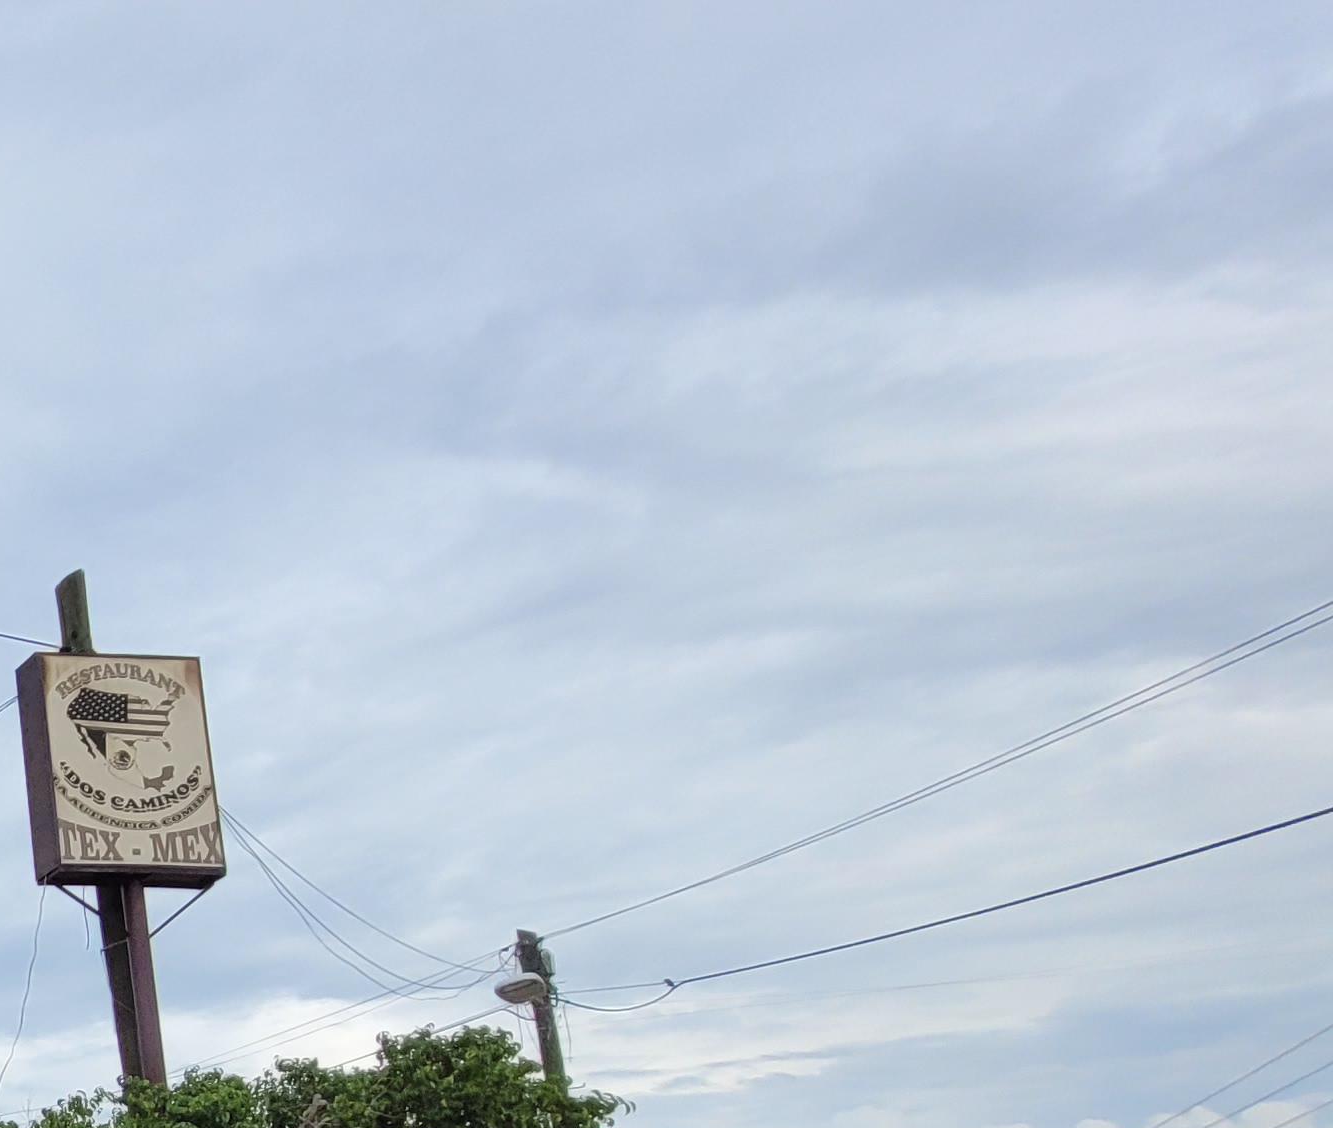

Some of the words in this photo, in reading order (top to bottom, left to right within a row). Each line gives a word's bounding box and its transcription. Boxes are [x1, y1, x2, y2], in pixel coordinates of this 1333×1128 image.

[55, 662, 185, 700] RESTAURANT
[52, 773, 68, 799] LA
[66, 796, 161, 830] AUTENTICA
[162, 785, 213, 827] COMIDA
[59, 820, 124, 861] TEX
[149, 822, 224, 864] MEX
